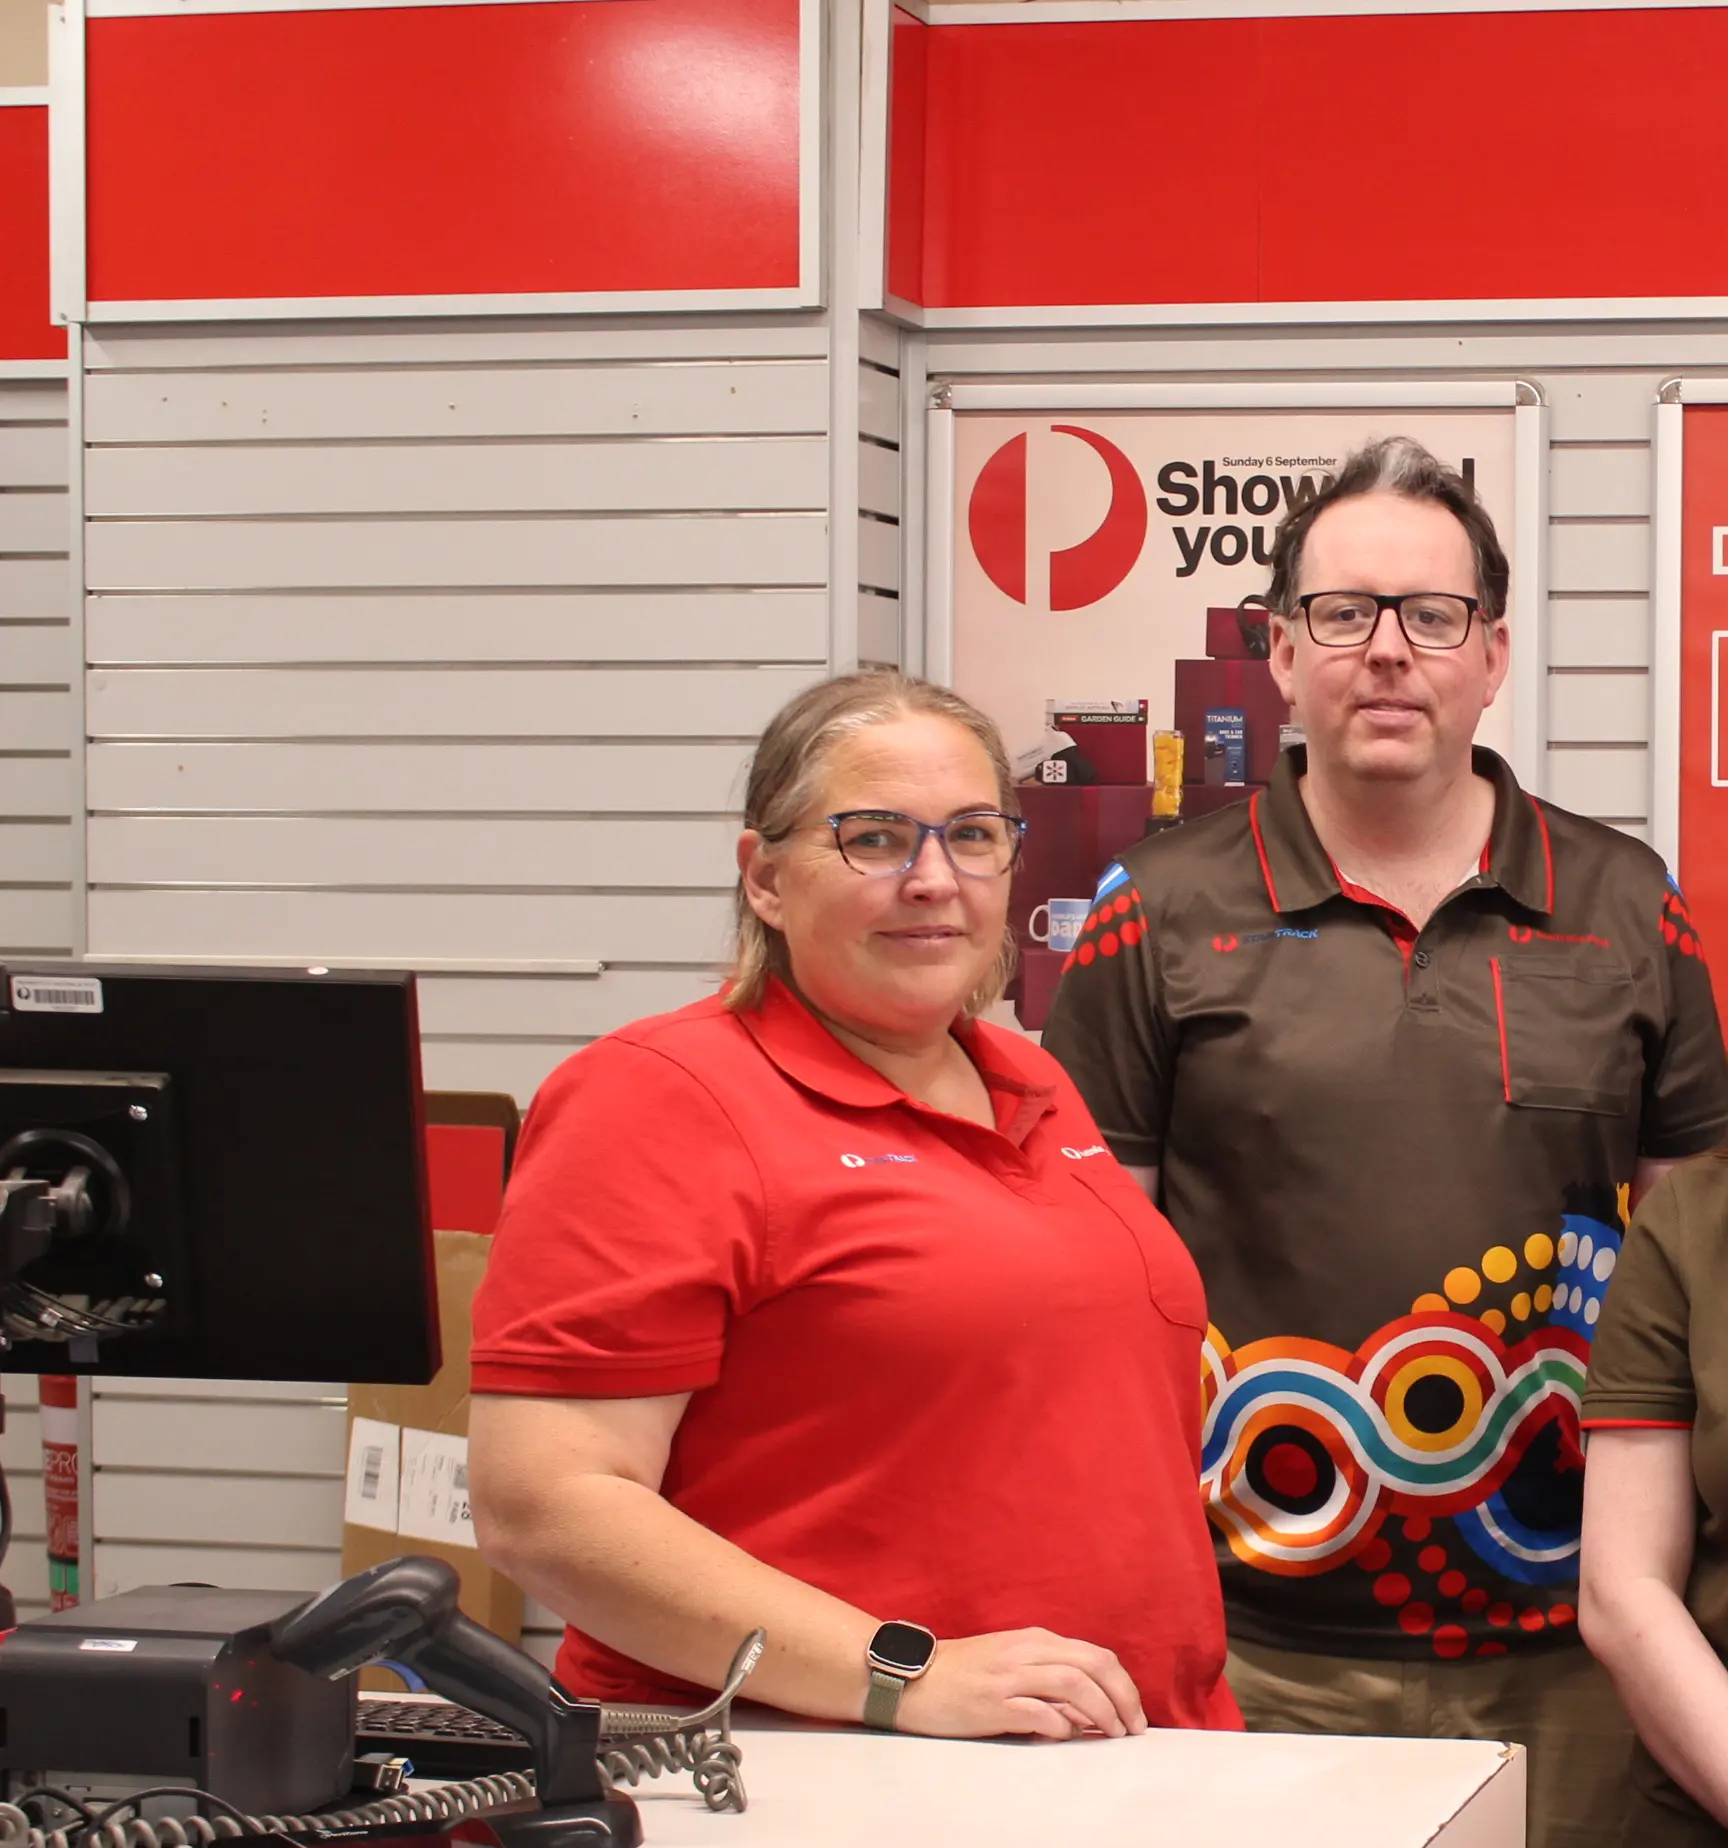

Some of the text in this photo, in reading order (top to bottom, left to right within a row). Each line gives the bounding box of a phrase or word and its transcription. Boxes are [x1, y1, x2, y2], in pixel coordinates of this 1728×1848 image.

[1223, 456, 1337, 468] Sunday 6 September
[1081, 715, 1112, 723] GARDEN
[1113, 715, 1136, 723] GUIDE
